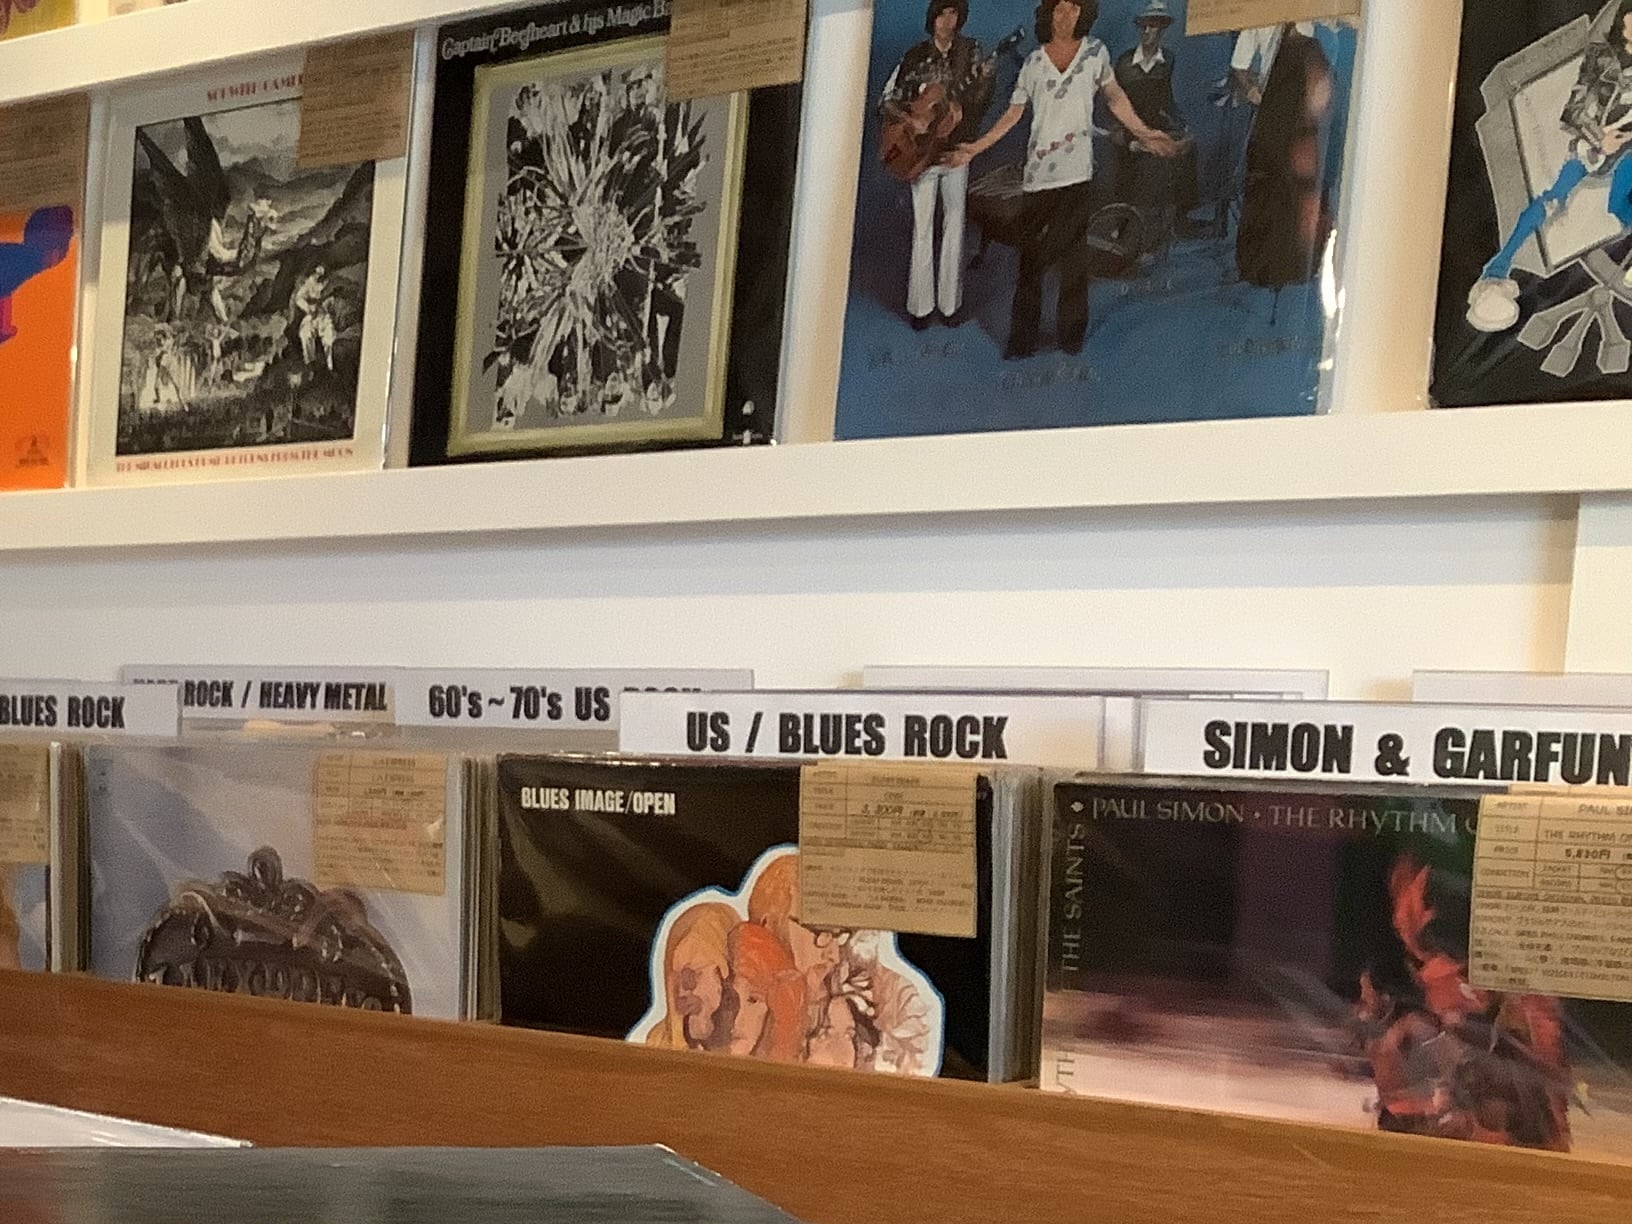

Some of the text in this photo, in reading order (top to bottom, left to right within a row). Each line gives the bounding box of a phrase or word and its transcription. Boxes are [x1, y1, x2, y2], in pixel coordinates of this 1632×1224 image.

[68, 695, 125, 729] ROCK
[183, 679, 234, 708] ROCK
[259, 681, 321, 710] HEAVY
[324, 681, 388, 712] METAL
[574, 686, 611, 722] US
[686, 711, 731, 752] US
[778, 712, 886, 756] BLUES
[903, 713, 1009, 759] ROCK
[1203, 719, 1354, 774] SIMON
[1374, 732, 1410, 777] &
[520, 786, 570, 810] BLUES
[1577, 803, 1611, 816] PAUL
[1092, 796, 1458, 838] PAUL SIMON THE RHYTHM
[1062, 823, 1086, 972] THE SAINTS
